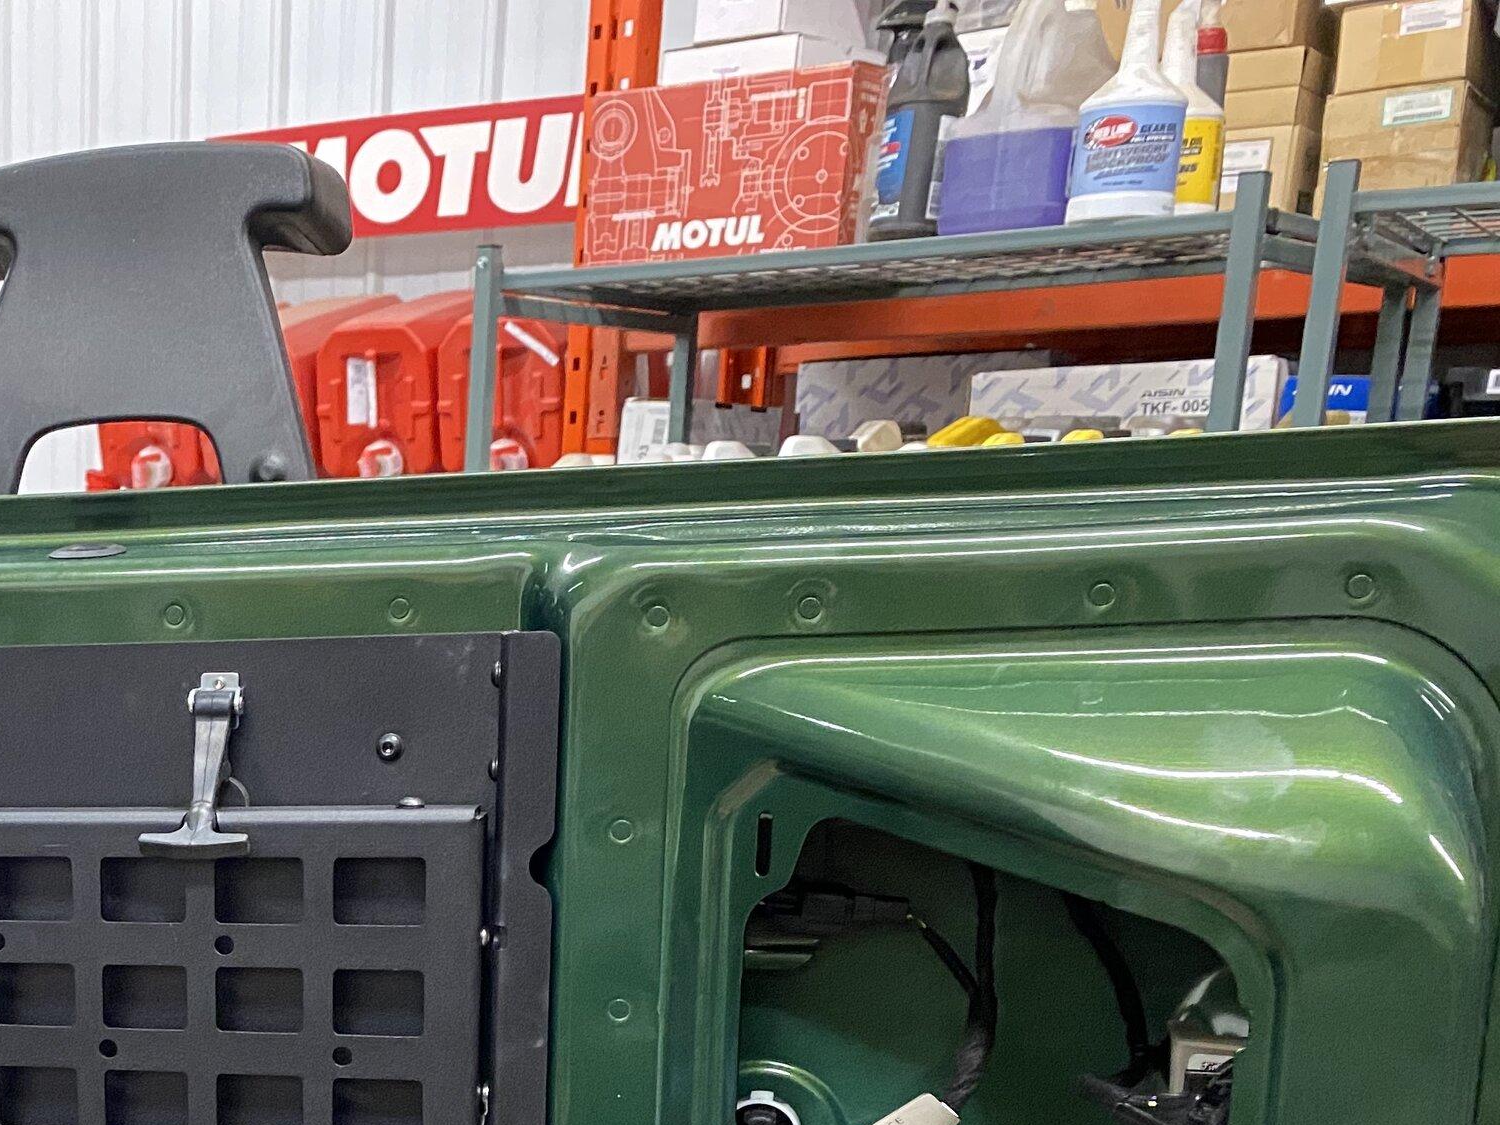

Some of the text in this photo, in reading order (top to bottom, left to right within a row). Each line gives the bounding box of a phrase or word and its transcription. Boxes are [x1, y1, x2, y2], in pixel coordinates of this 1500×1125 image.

[1140, 124, 1165, 134] GEAR
[650, 214, 765, 252] MOTUL
[1141, 388, 1186, 398] AISIN
